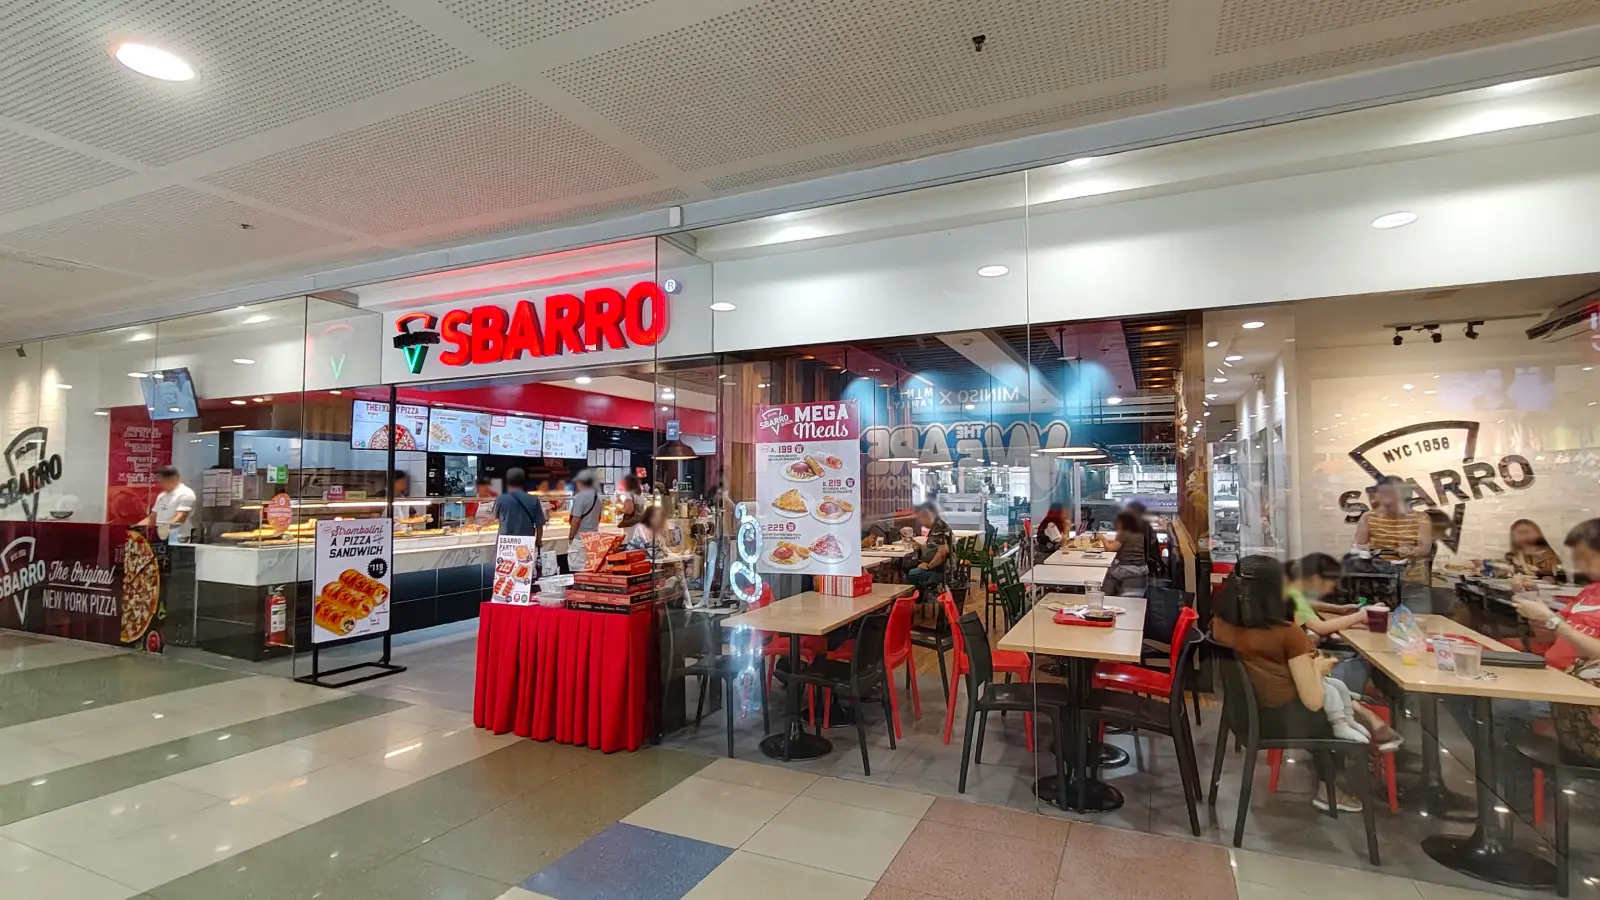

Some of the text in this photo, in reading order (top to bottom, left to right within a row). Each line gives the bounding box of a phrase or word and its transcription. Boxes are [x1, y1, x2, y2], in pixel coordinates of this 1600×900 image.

[440, 281, 667, 367] SBARRO
[400, 406, 419, 415] PIZZA
[795, 404, 849, 422] MEGA
[760, 413, 789, 430] SBARRO
[793, 421, 849, 439] Meals
[778, 445, 793, 454] 199
[1382, 444, 1413, 464] NYC
[828, 479, 842, 487] 219
[1338, 454, 1536, 525] SARRO
[331, 524, 384, 537] Strombolini
[767, 523, 784, 532] 229
[330, 535, 371, 547] A PIZZA
[499, 537, 522, 545] SBARRO
[329, 546, 384, 558] SANDWICH
[0, 559, 46, 600] SBARRO
[49, 560, 116, 590] The Original
[42, 588, 118, 617] NEW YORK PIZZA
